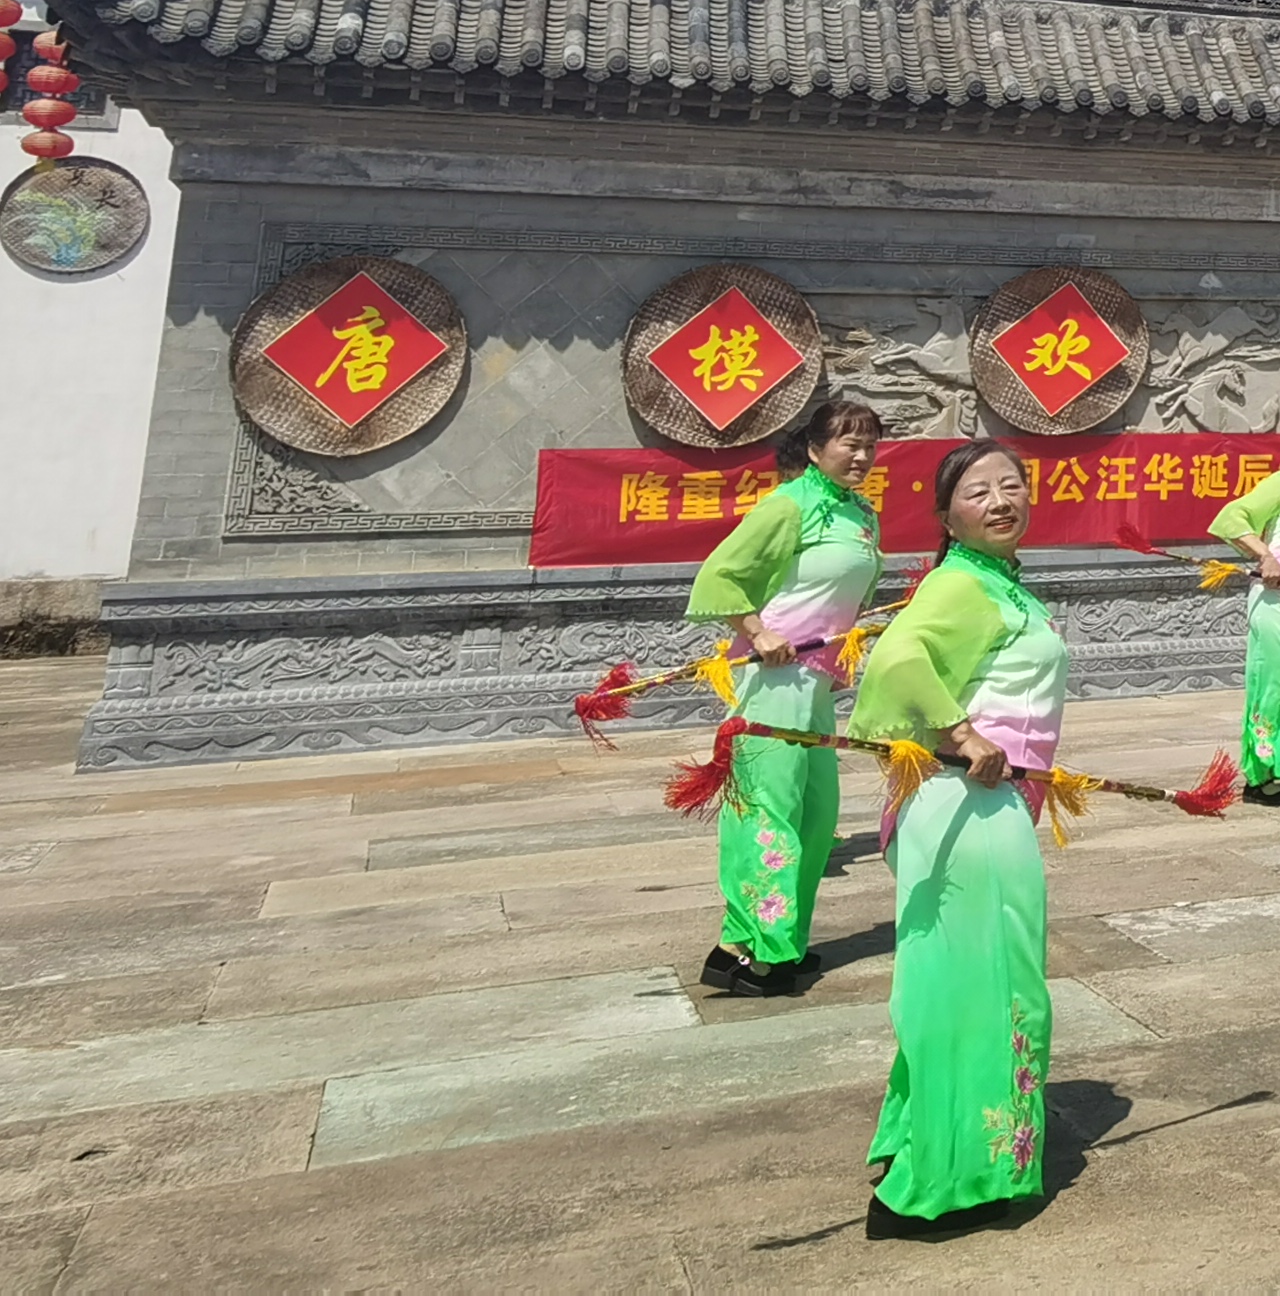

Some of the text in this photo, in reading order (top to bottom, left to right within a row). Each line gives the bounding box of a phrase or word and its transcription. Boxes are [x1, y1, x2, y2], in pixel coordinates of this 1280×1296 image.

[315, 307, 394, 393] 唐
[689, 325, 764, 392] 模
[1024, 319, 1092, 380] 欢
